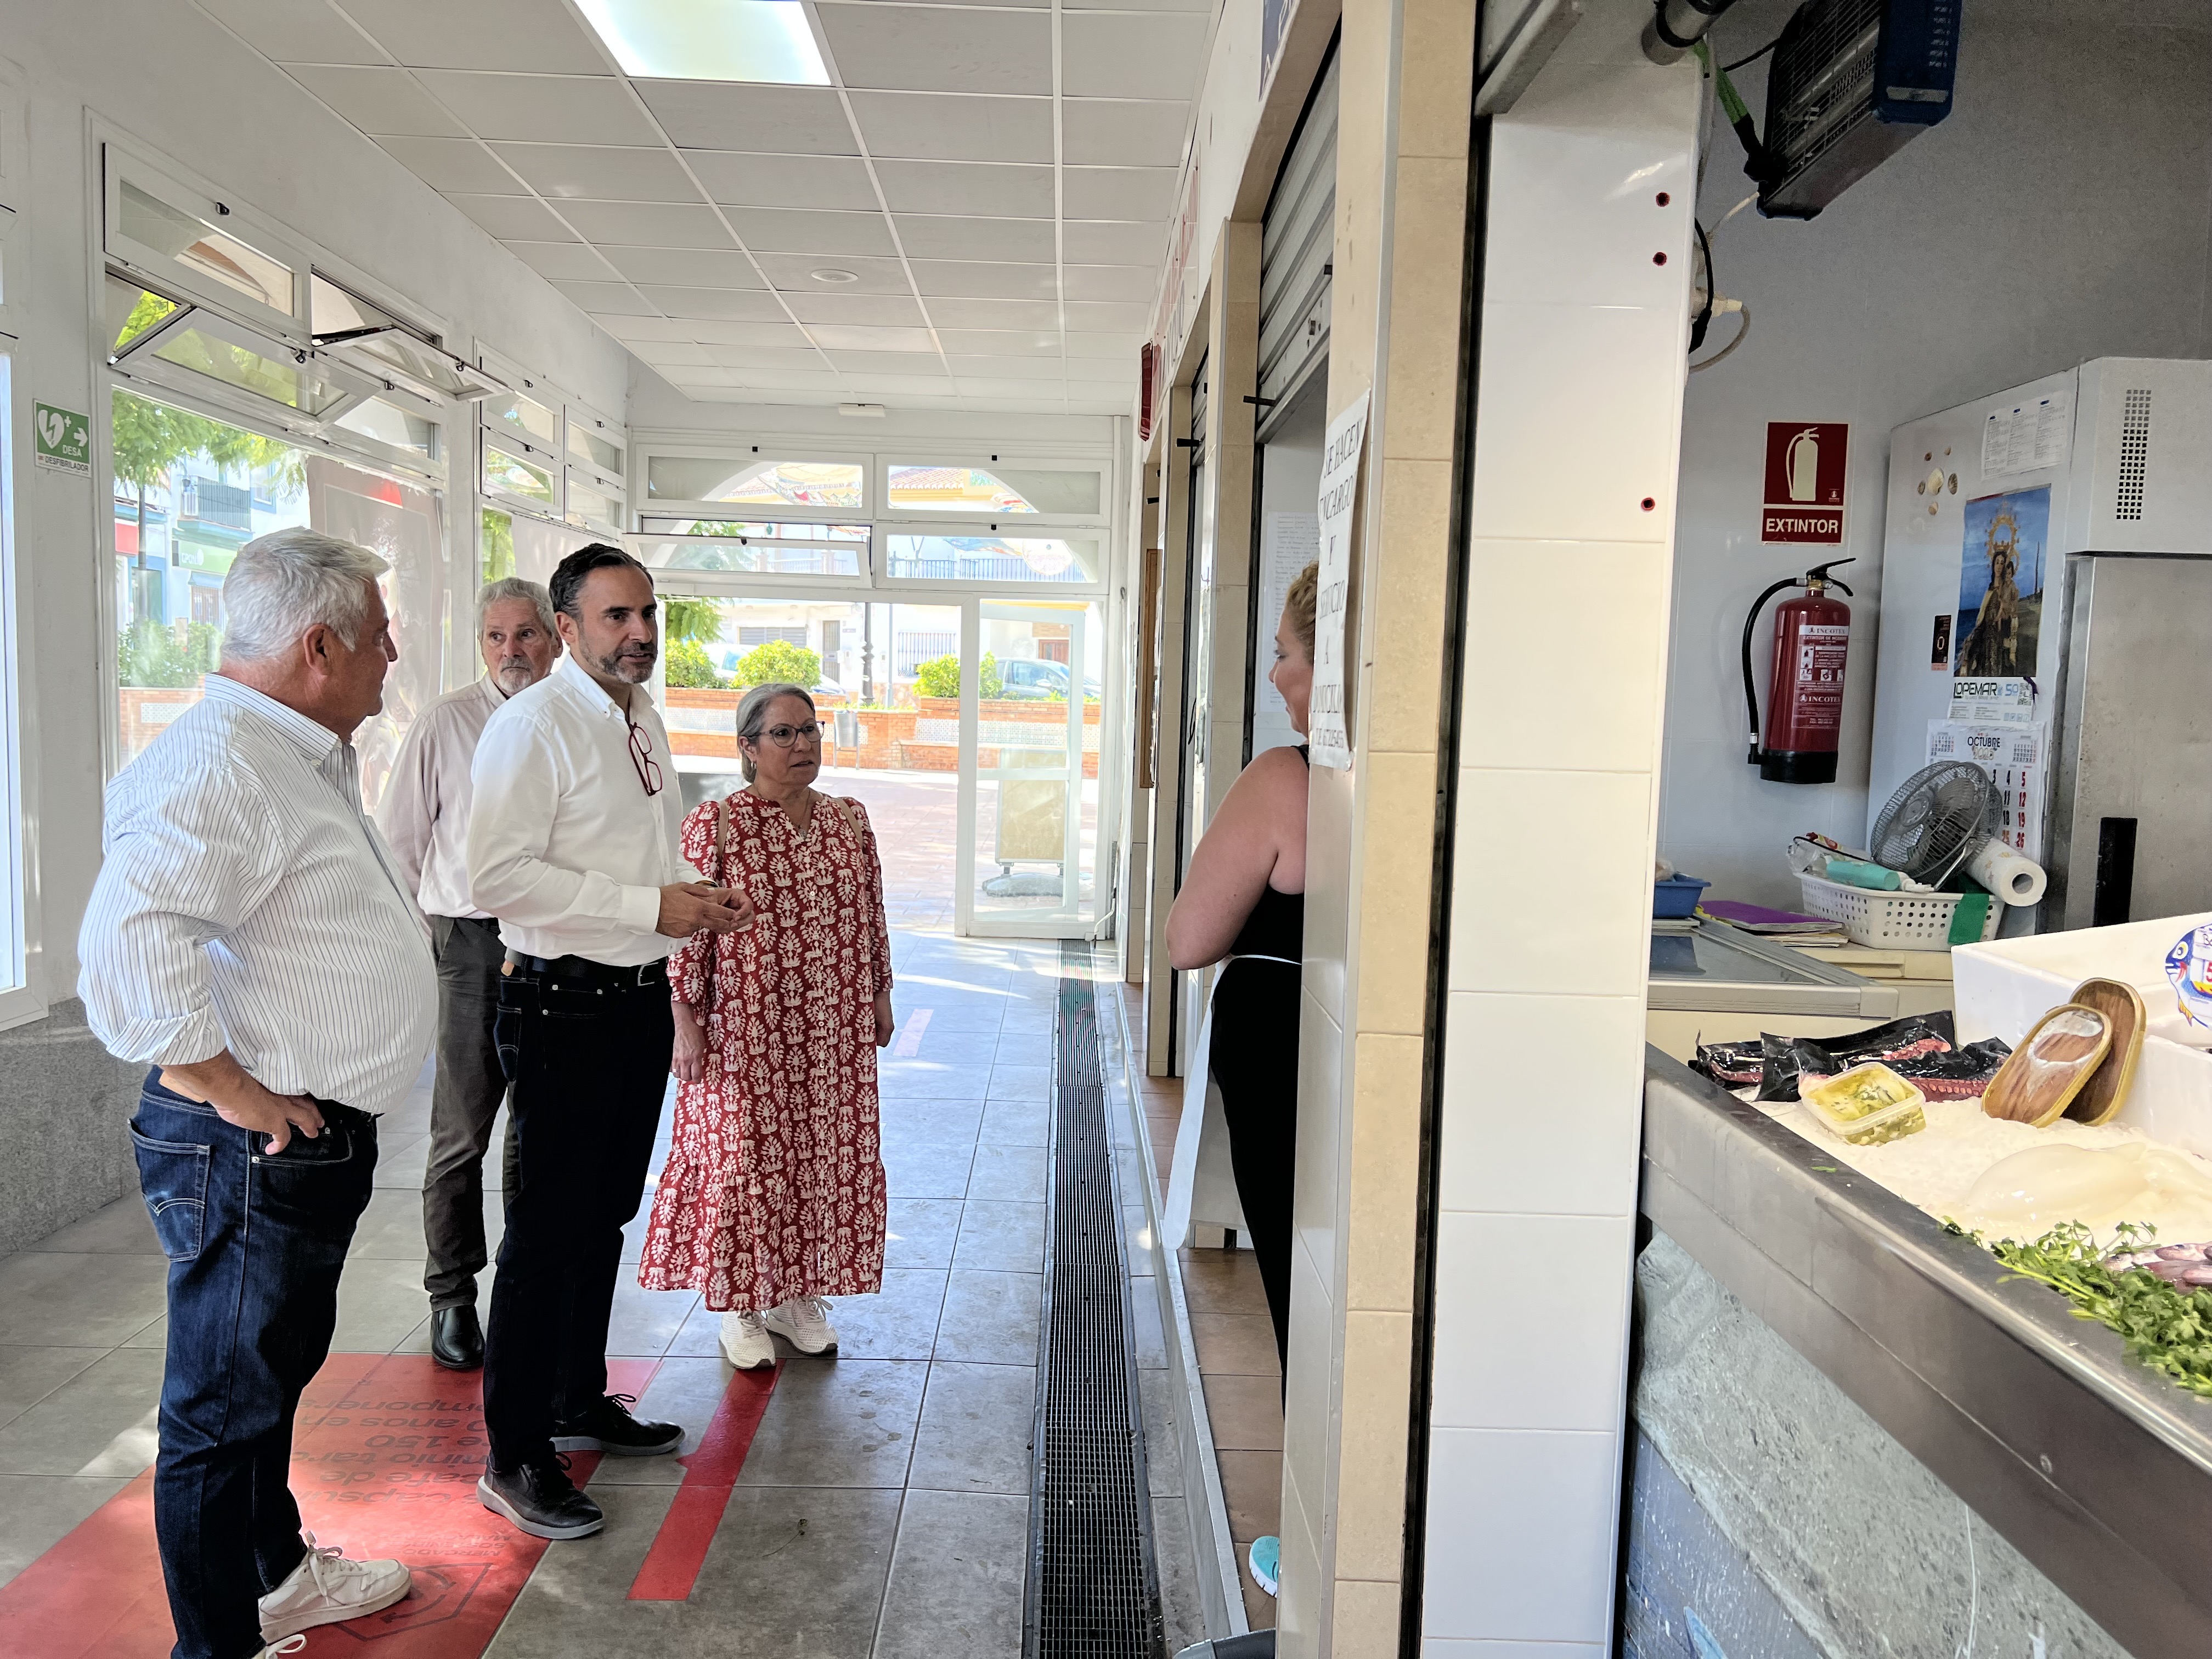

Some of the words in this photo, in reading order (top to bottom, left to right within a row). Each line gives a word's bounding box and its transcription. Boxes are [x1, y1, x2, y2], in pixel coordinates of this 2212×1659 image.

[63, 444, 82, 458] DESA
[45, 456, 89, 472] DESFIBRILADOR
[1319, 471, 1356, 527] ENCARGO
[1765, 518, 1838, 533] EXTINTOR
[1954, 682, 1997, 698] LOPEMAR
[1967, 736, 2001, 748] OCTUBRE
[1993, 769, 1996, 784] 3
[2006, 770, 2011, 785] 4
[2021, 771, 2025, 787] 5
[2004, 790, 2010, 805] 11
[2019, 792, 2026, 807] 12
[2003, 810, 2010, 826] 18
[2018, 812, 2025, 828] 19
[2016, 832, 2025, 849] 26
[299, 1415, 351, 1427] en
[364, 1435, 450, 1449] 150
[320, 1471, 376, 1486] de
[392, 1548, 501, 1556] MERCADOS
